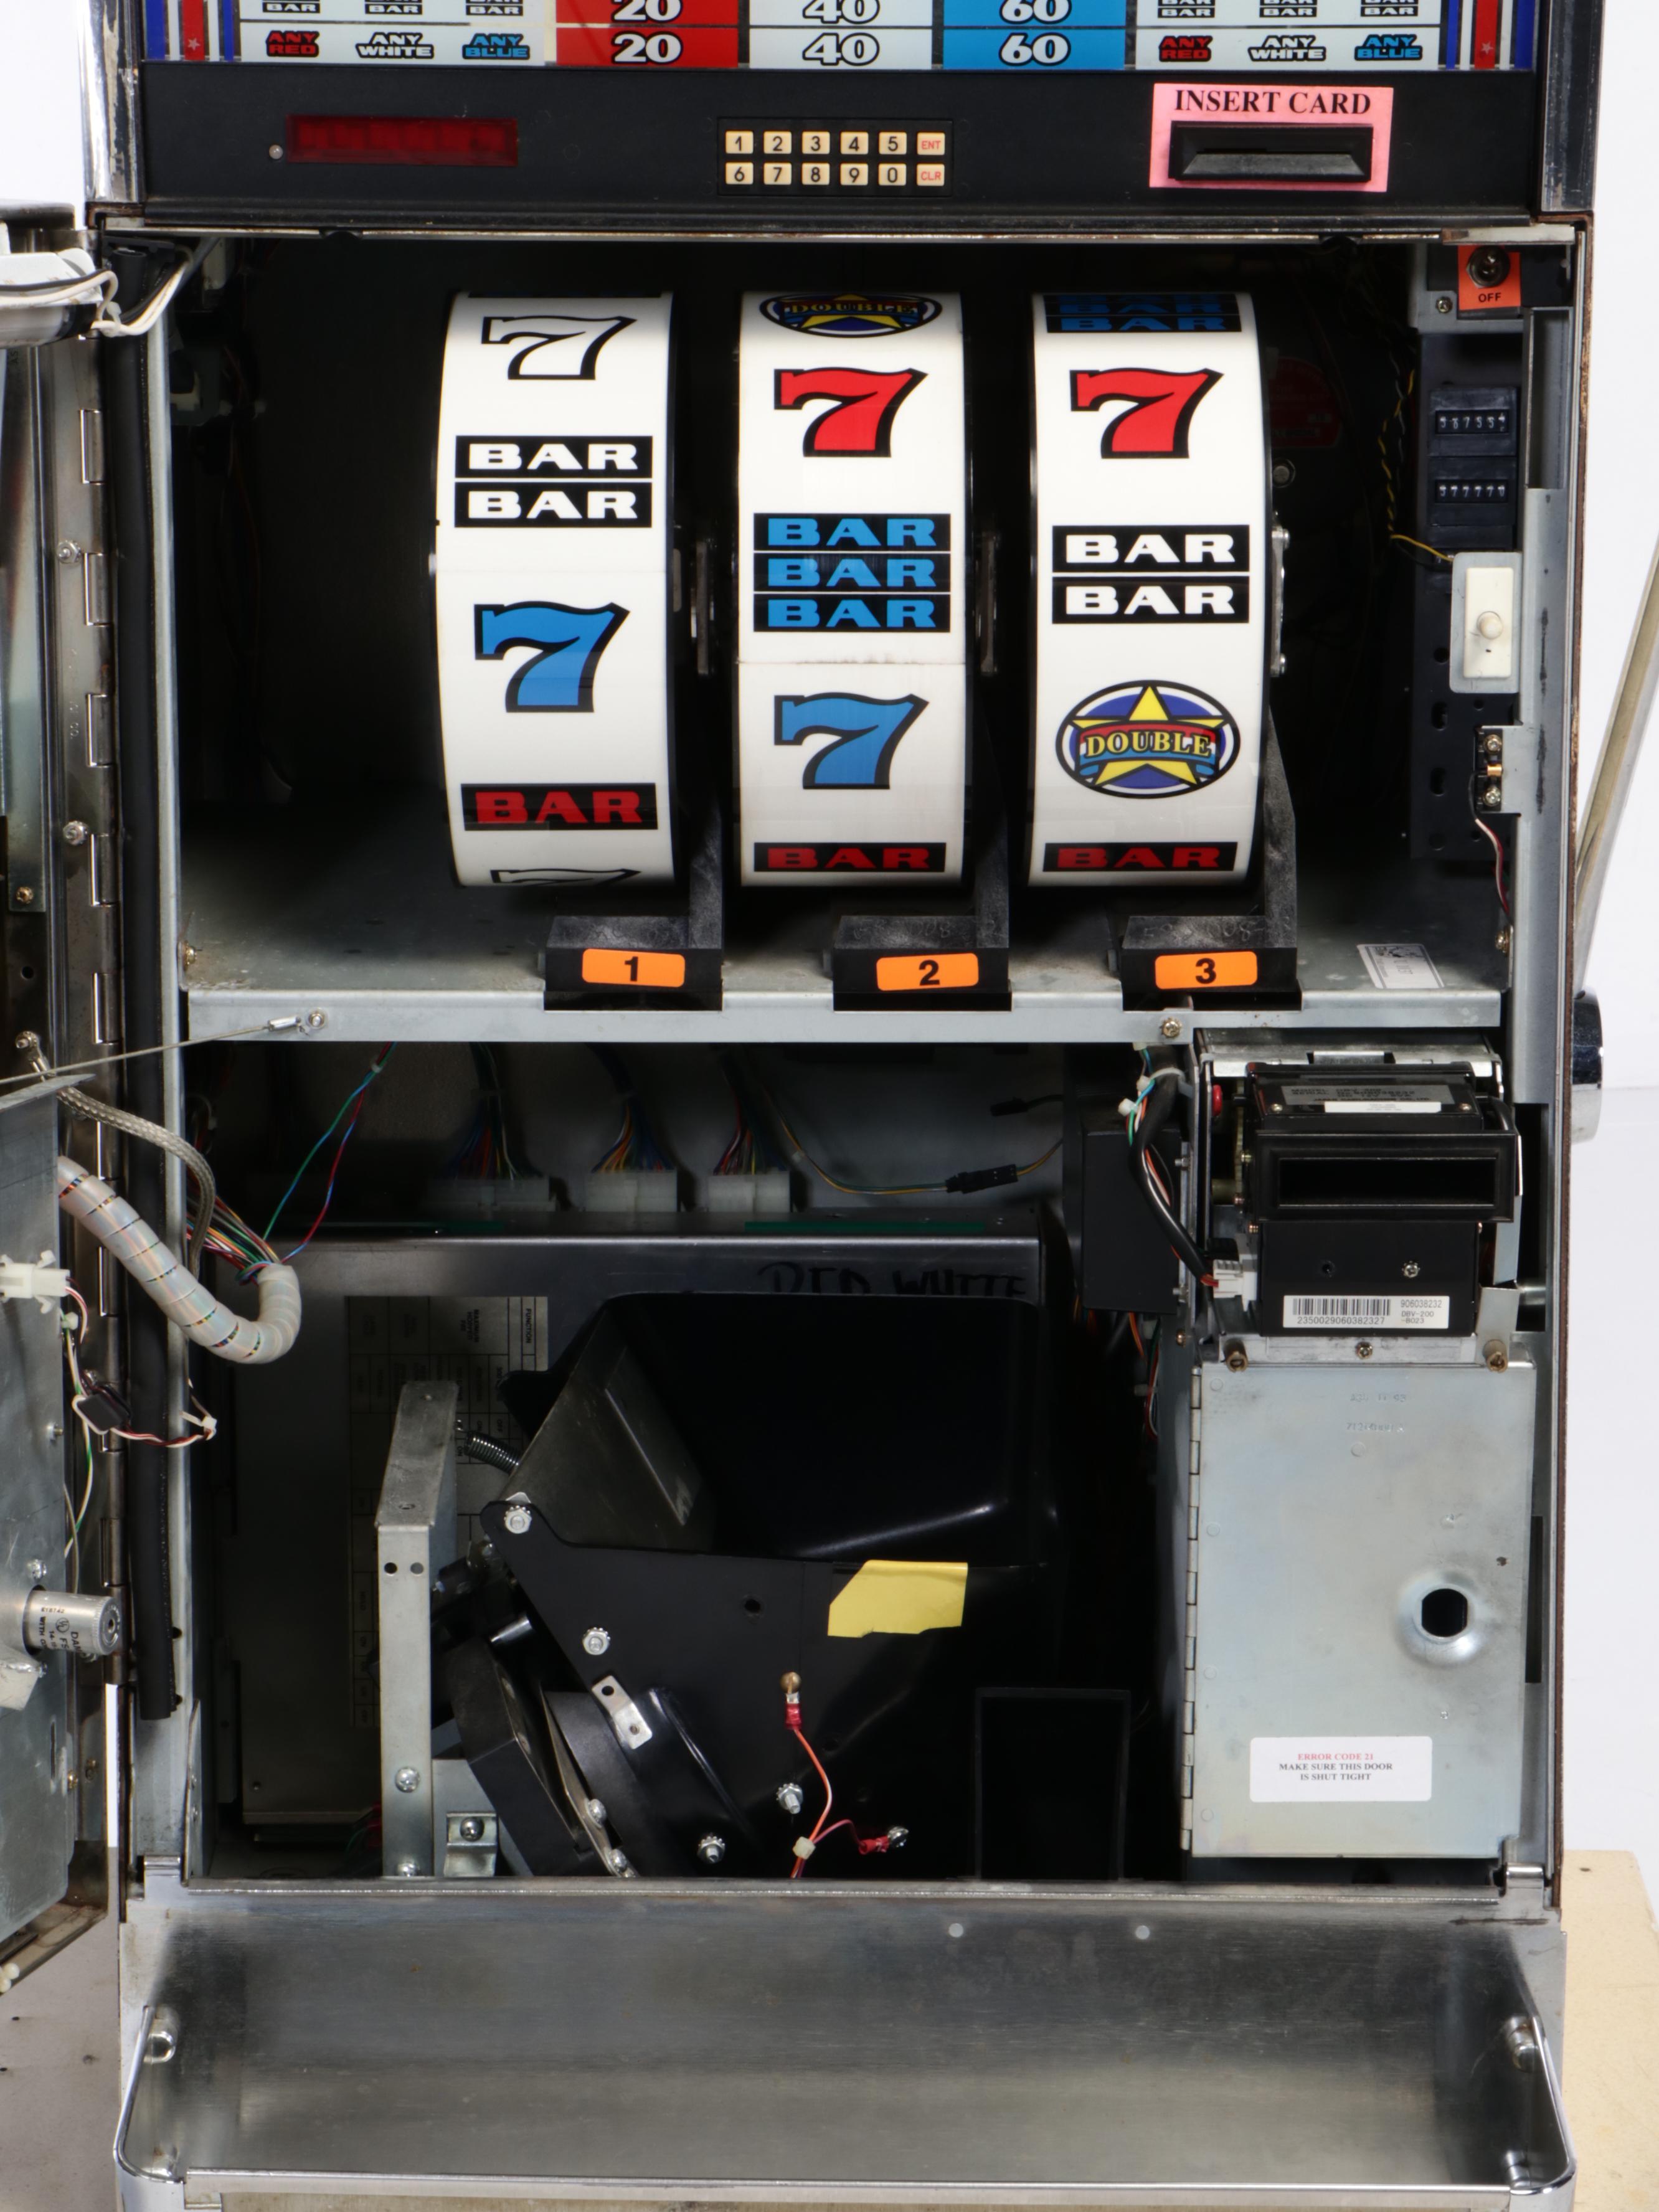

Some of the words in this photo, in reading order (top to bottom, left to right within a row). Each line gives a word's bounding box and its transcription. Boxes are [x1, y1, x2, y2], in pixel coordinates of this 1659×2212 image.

[267, 4, 316, 12] BAR
[368, 5, 418, 13] BAR
[470, 6, 519, 15] BAR
[613, 0, 683, 24] 20
[803, 0, 880, 24] 40
[999, 0, 1072, 24] 60
[1161, 8, 1212, 16] BAR
[1263, 8, 1313, 16] BAR
[1364, 7, 1415, 15] BAR
[268, 31, 317, 43] ANY
[372, 33, 422, 45] ANY
[472, 34, 521, 46] ANY
[1161, 37, 1211, 49] ANY
[1264, 37, 1313, 49] ANY
[1366, 37, 1416, 47] ANY
[268, 44, 316, 55] RED
[358, 45, 433, 57] WHITE
[465, 47, 527, 58] BLUE
[613, 32, 683, 64] 20
[803, 32, 880, 66] 40
[998, 32, 1071, 67] 60
[1161, 49, 1208, 59] RED
[1250, 49, 1325, 60] WHITE
[1357, 48, 1420, 59] BLUE
[1175, 90, 1280, 112] INSERT
[1289, 92, 1371, 115] CARD
[734, 137, 742, 151] 1
[772, 136, 783, 151] 2
[811, 136, 821, 151] 3
[849, 136, 859, 151] 4
[887, 136, 898, 151] 5
[921, 140, 940, 150] ENT
[734, 167, 745, 182] 6
[773, 167, 783, 182] 7
[811, 167, 821, 182] 8
[849, 168, 859, 182] 9
[887, 168, 898, 182] 0
[920, 171, 941, 181] CLR
[1478, 293, 1501, 303] OFF
[789, 300, 918, 314] DOUBLE
[1061, 317, 1226, 331] BAR
[481, 316, 637, 380] 7
[774, 367, 929, 458] 7
[1069, 367, 1224, 459] 7
[469, 443, 638, 470] BAR
[468, 491, 638, 519] BAR
[768, 518, 936, 546] BAR
[1066, 534, 1236, 563] BAR
[768, 559, 936, 587] BAR
[1066, 586, 1236, 615] BAR
[768, 599, 936, 627] BAR
[474, 601, 630, 712] 7
[774, 692, 929, 790] 7
[1084, 732, 1212, 758] DOUBLE
[475, 791, 643, 824] BAR
[768, 848, 929, 869] BAR
[1058, 848, 1219, 868] BAR
[624, 956, 638, 981] 1
[919, 960, 940, 986] 2
[1194, 958, 1218, 985] 3
[1401, 1299, 1442, 1308] 906038232
[1297, 1316, 1386, 1325] 2350029060382327
[1298, 1753, 1331, 1761] ERROR
[1335, 1753, 1361, 1761] CODE
